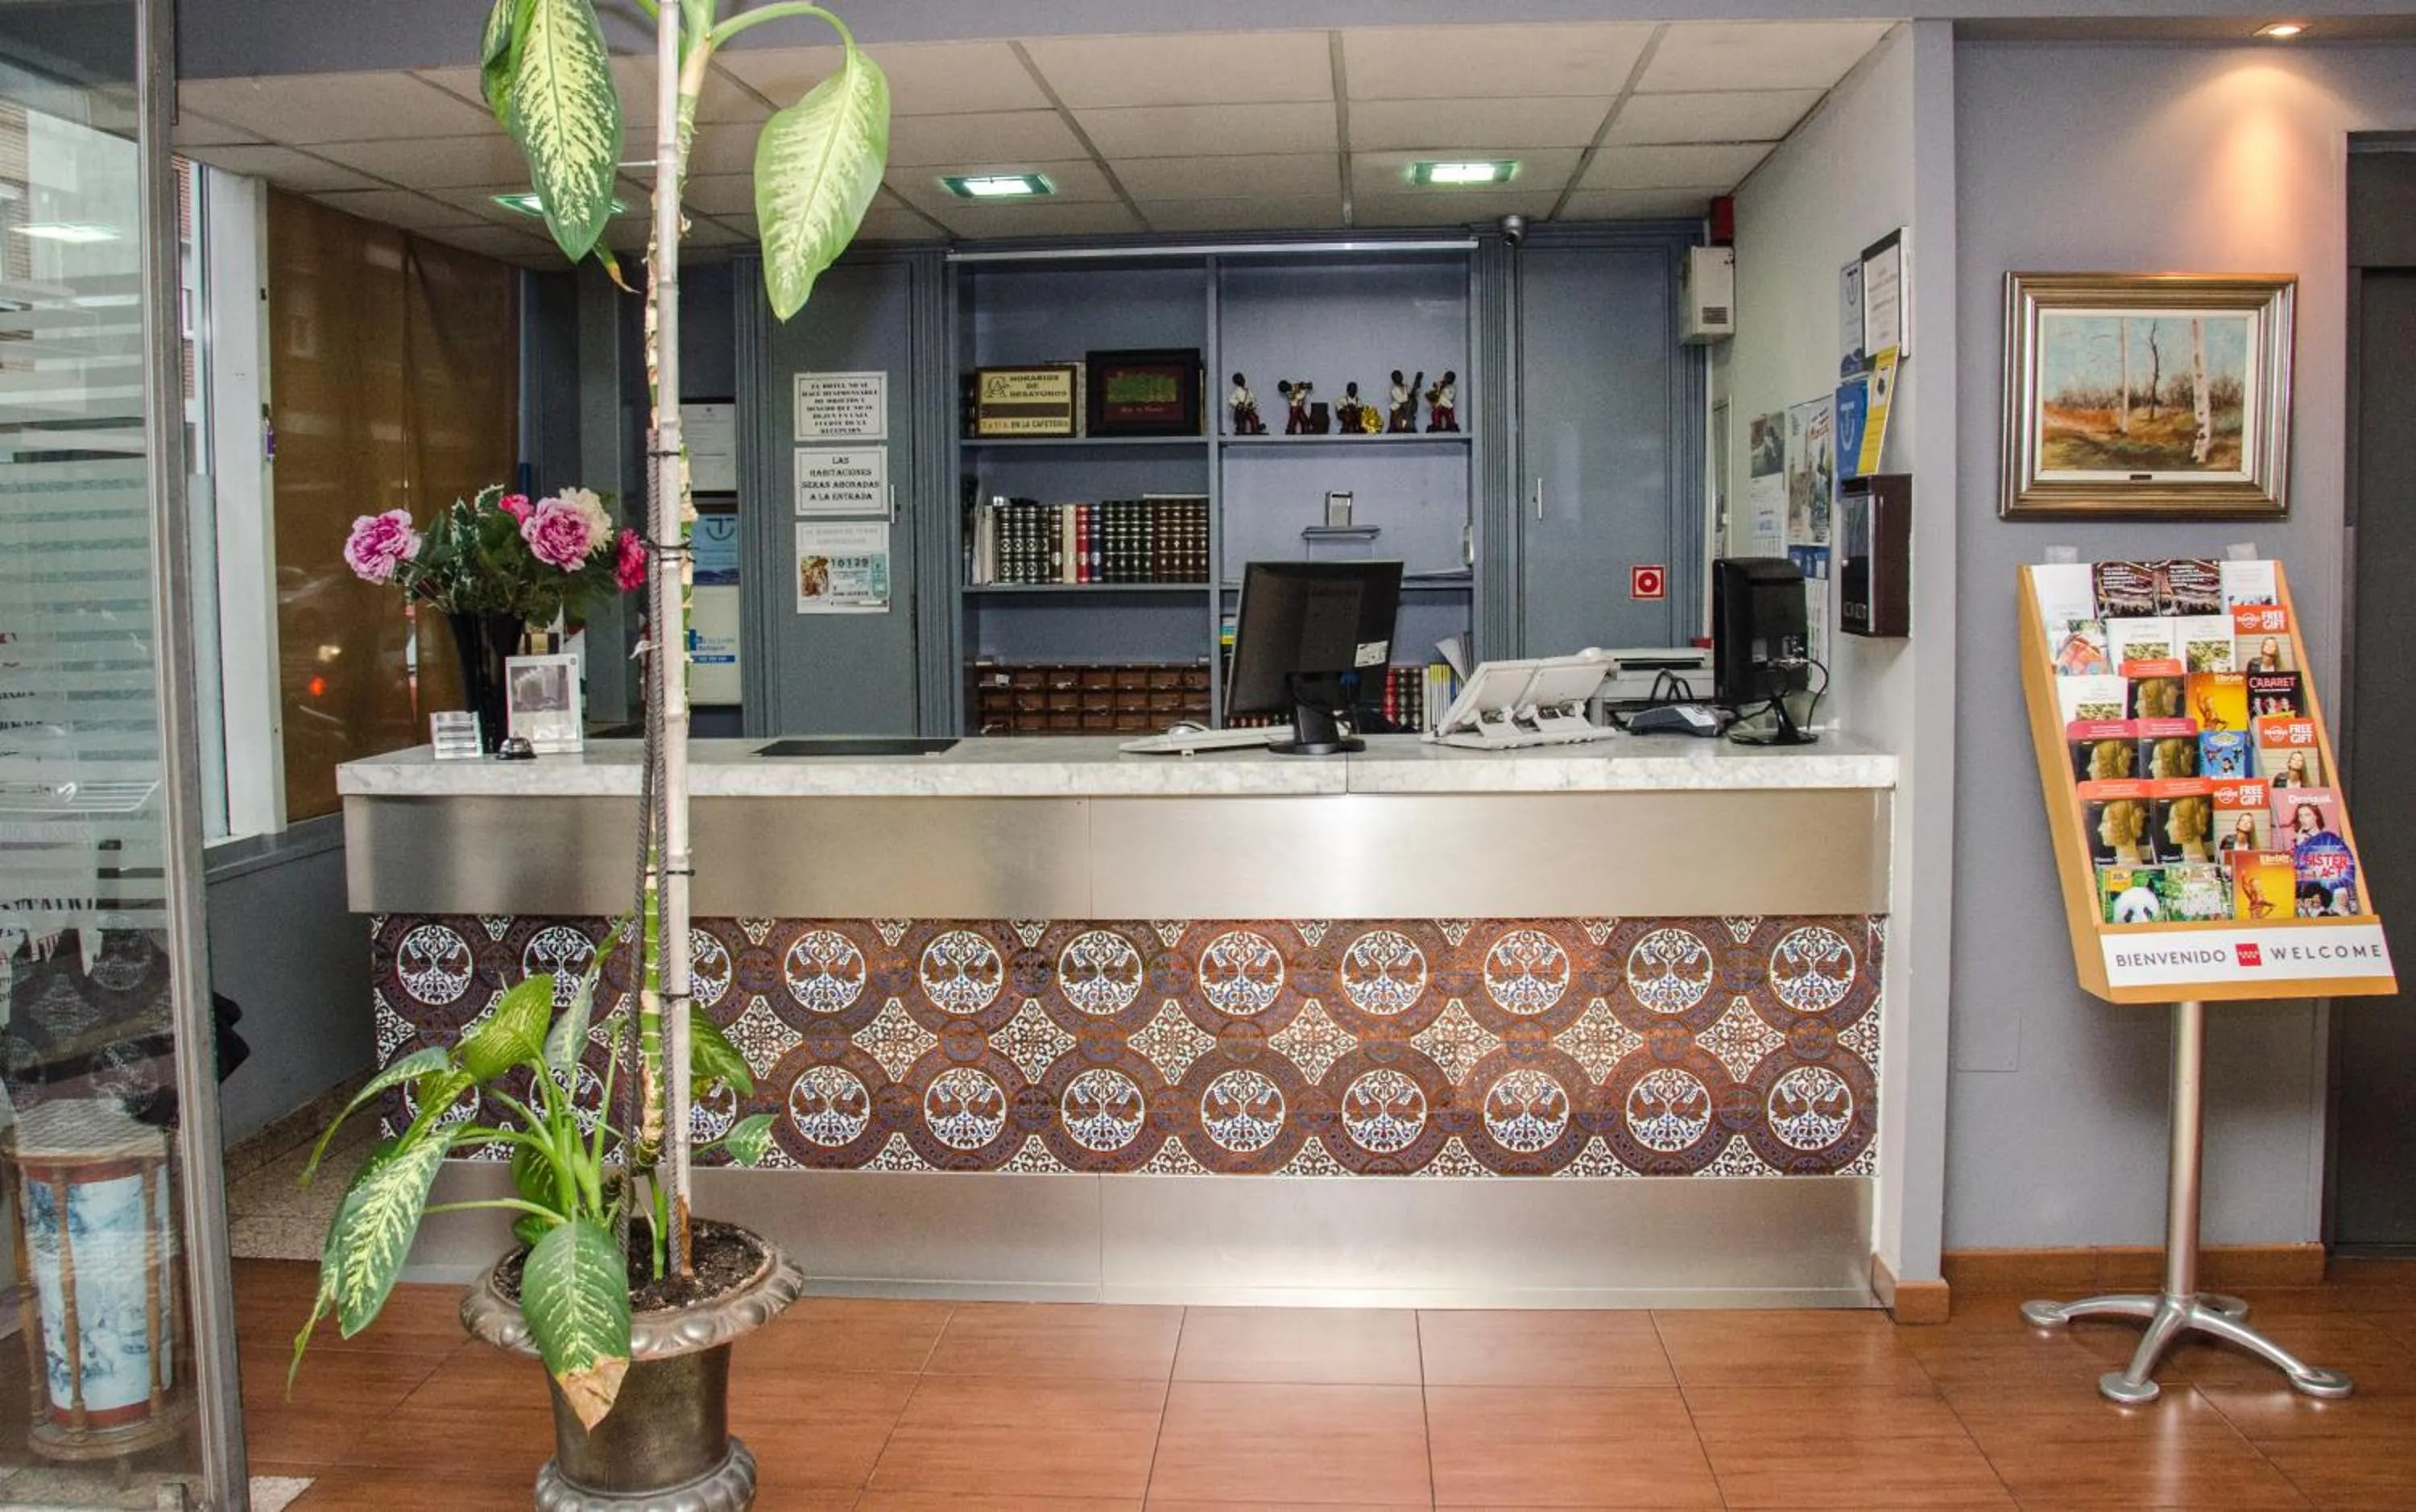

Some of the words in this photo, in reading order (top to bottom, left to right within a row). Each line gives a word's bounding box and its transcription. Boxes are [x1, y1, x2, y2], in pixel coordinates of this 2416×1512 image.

[832, 456, 850, 465] LAS
[2261, 609, 2285, 621] FREE
[2248, 676, 2296, 688] CABARET
[2289, 724, 2314, 734] FREE
[2290, 733, 2313, 743] GIFT
[2240, 785, 2264, 795] FREE
[2240, 795, 2263, 805] GIFT
[2305, 852, 2349, 867] SISTER
[2116, 948, 2226, 968] BIENVENIDO
[2270, 944, 2381, 960] WELCOME
